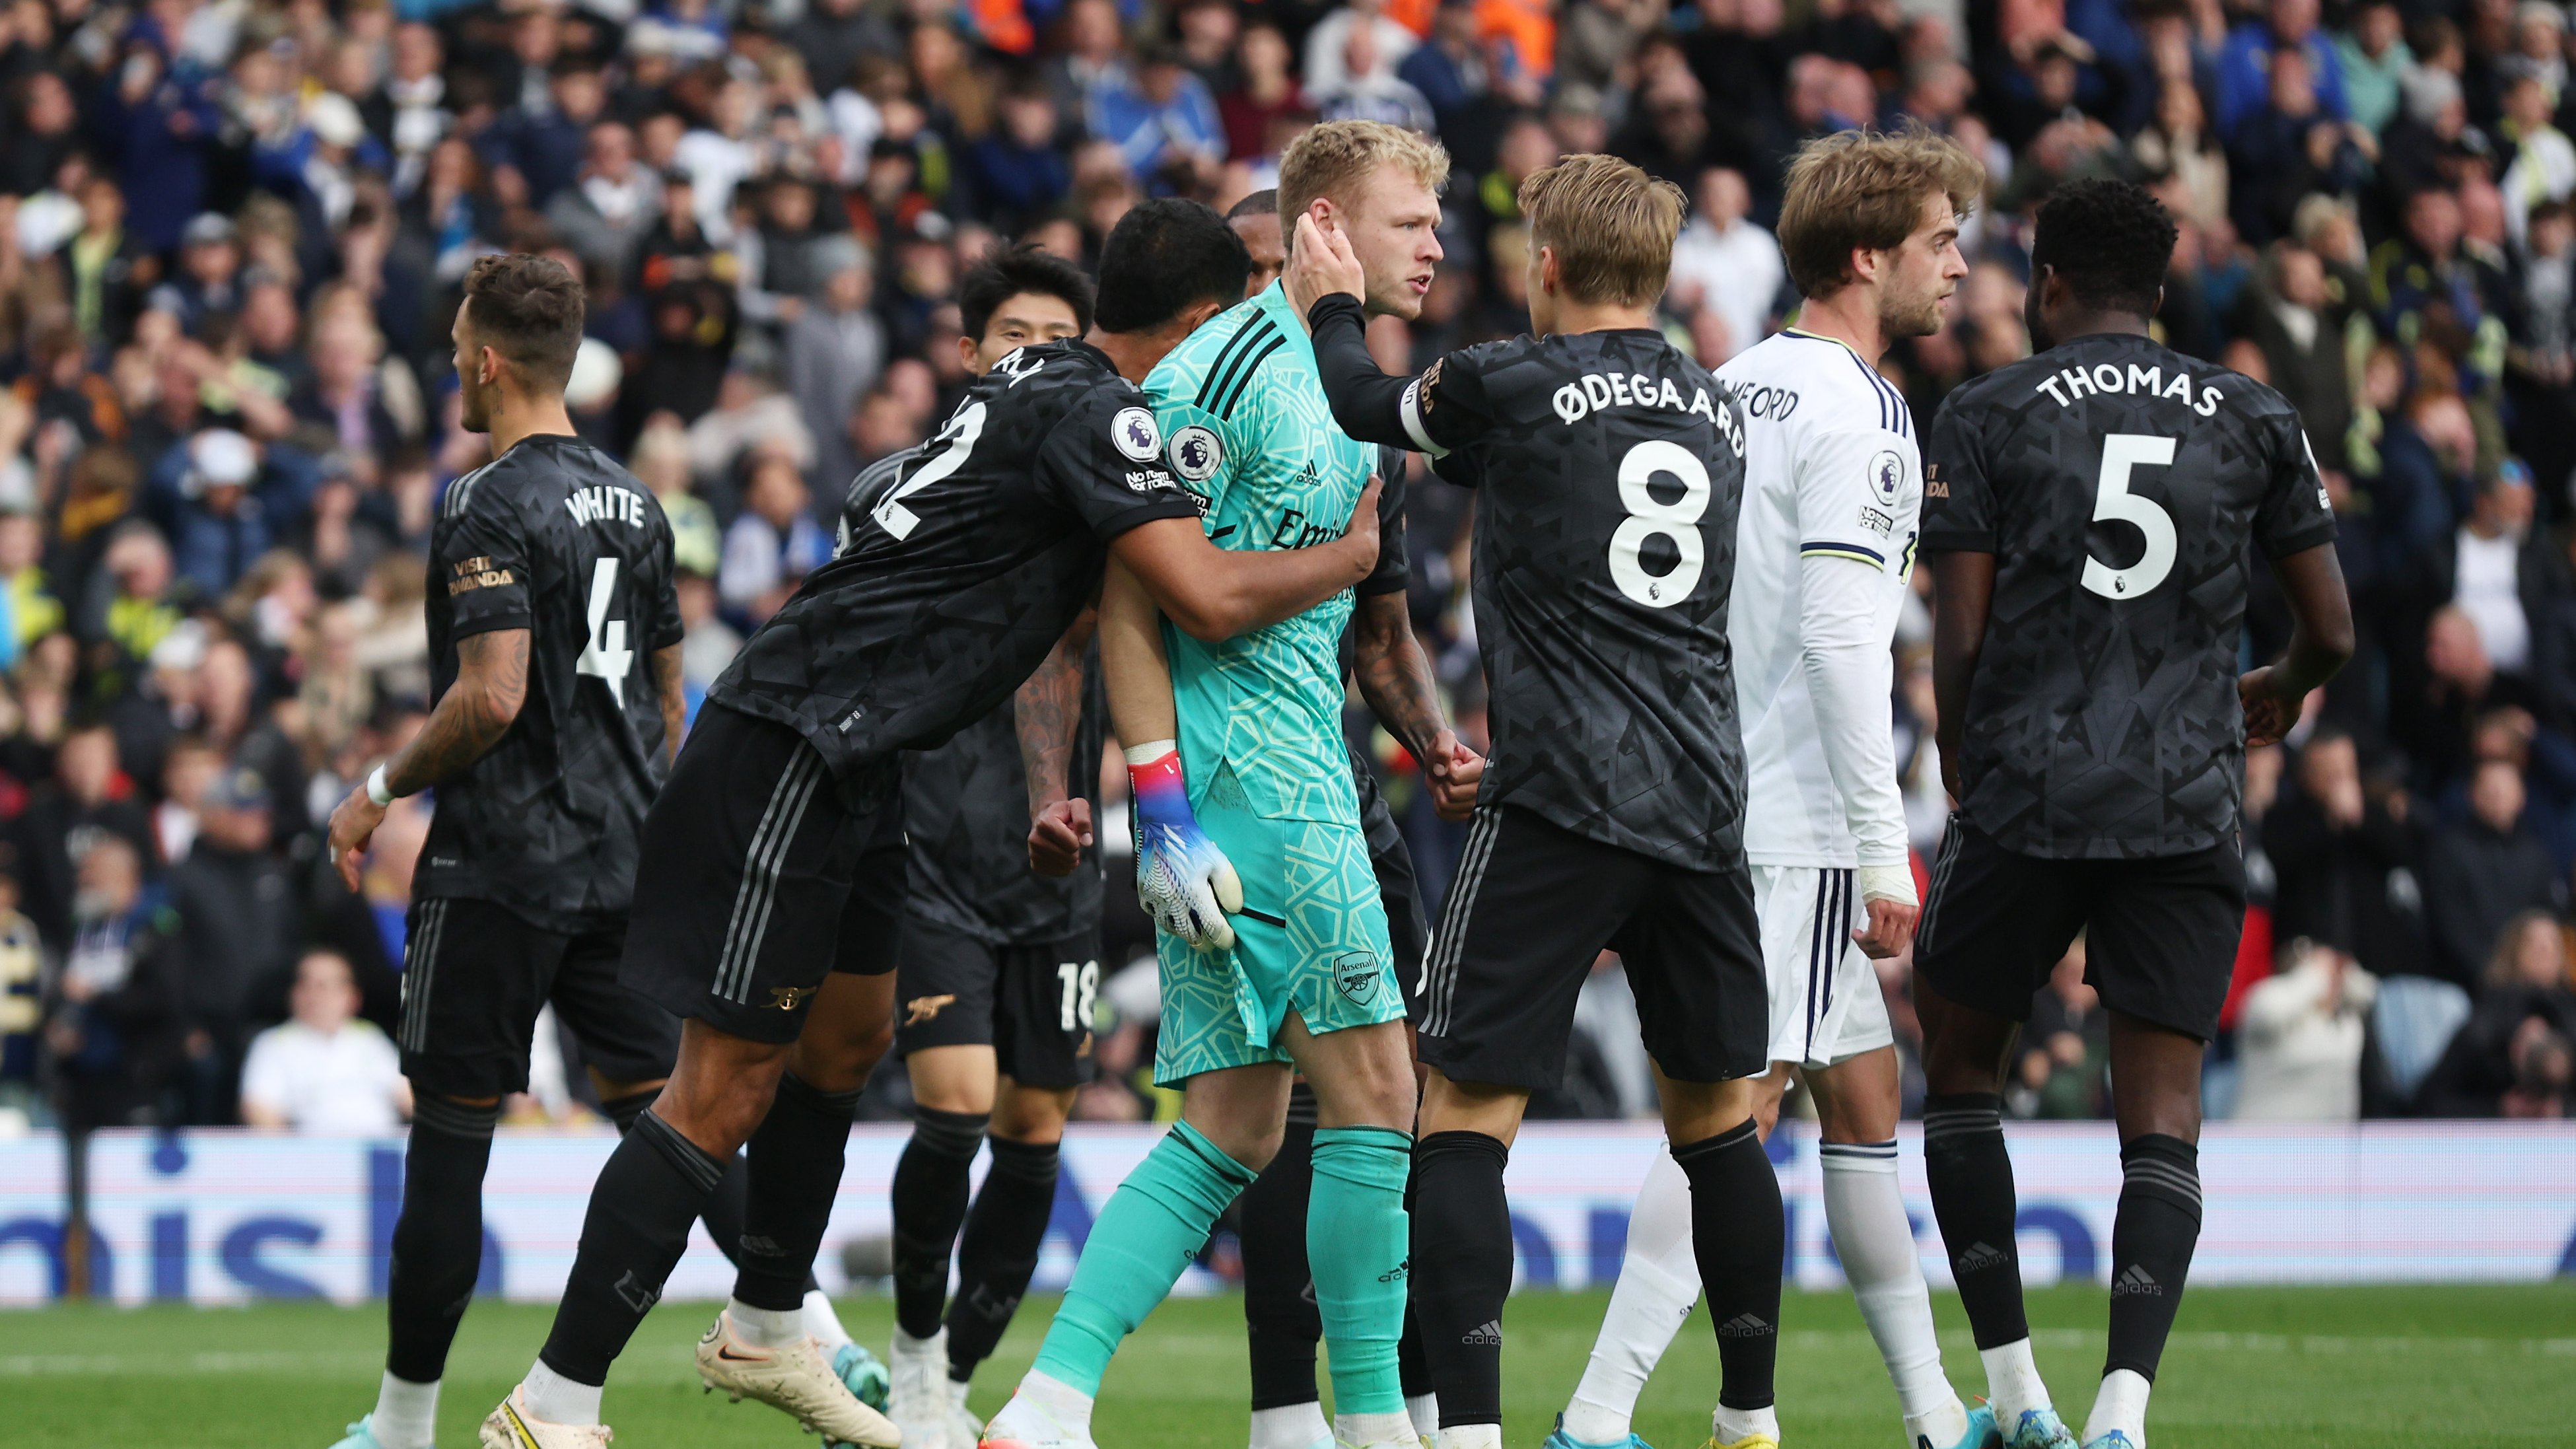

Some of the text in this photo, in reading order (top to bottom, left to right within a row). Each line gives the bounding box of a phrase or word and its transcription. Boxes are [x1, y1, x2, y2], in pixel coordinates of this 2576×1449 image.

[1720, 379, 1799, 421] MFORD
[2036, 364, 2223, 416] THOMAS
[1553, 372, 1745, 458] ØDEGAARD
[870, 394, 987, 542] 2
[1126, 471, 1144, 483] No
[1130, 481, 1146, 491] for
[565, 485, 646, 528] WHITE
[1609, 440, 1711, 608] 8
[1860, 505, 1875, 520] No
[2080, 433, 2178, 600] 5
[454, 555, 491, 576] VISIT
[575, 557, 635, 711] 4
[1340, 958, 1372, 972] Arsenal
[1057, 960, 1099, 1032] 18
[2111, 1283, 2162, 1300] adidas
[1719, 1325, 1774, 1337] adidas
